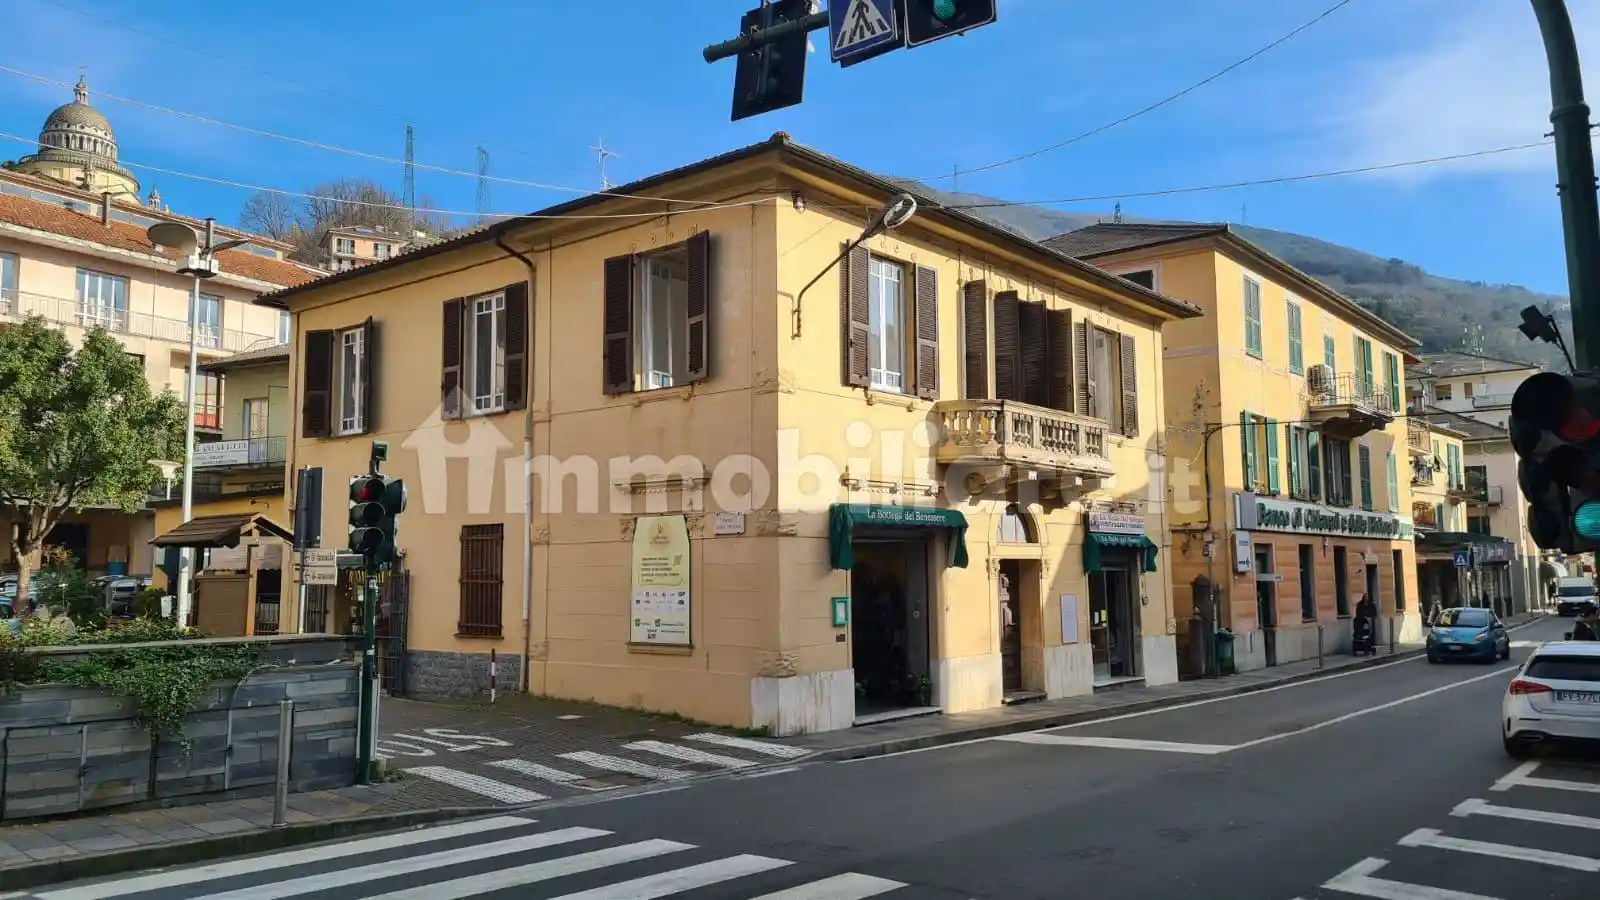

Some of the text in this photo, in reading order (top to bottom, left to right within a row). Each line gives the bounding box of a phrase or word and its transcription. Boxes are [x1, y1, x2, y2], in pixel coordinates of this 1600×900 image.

[867, 509, 946, 522] La Bottega del Benessere
[1256, 503, 1290, 528] Banco
[1292, 507, 1302, 529] di
